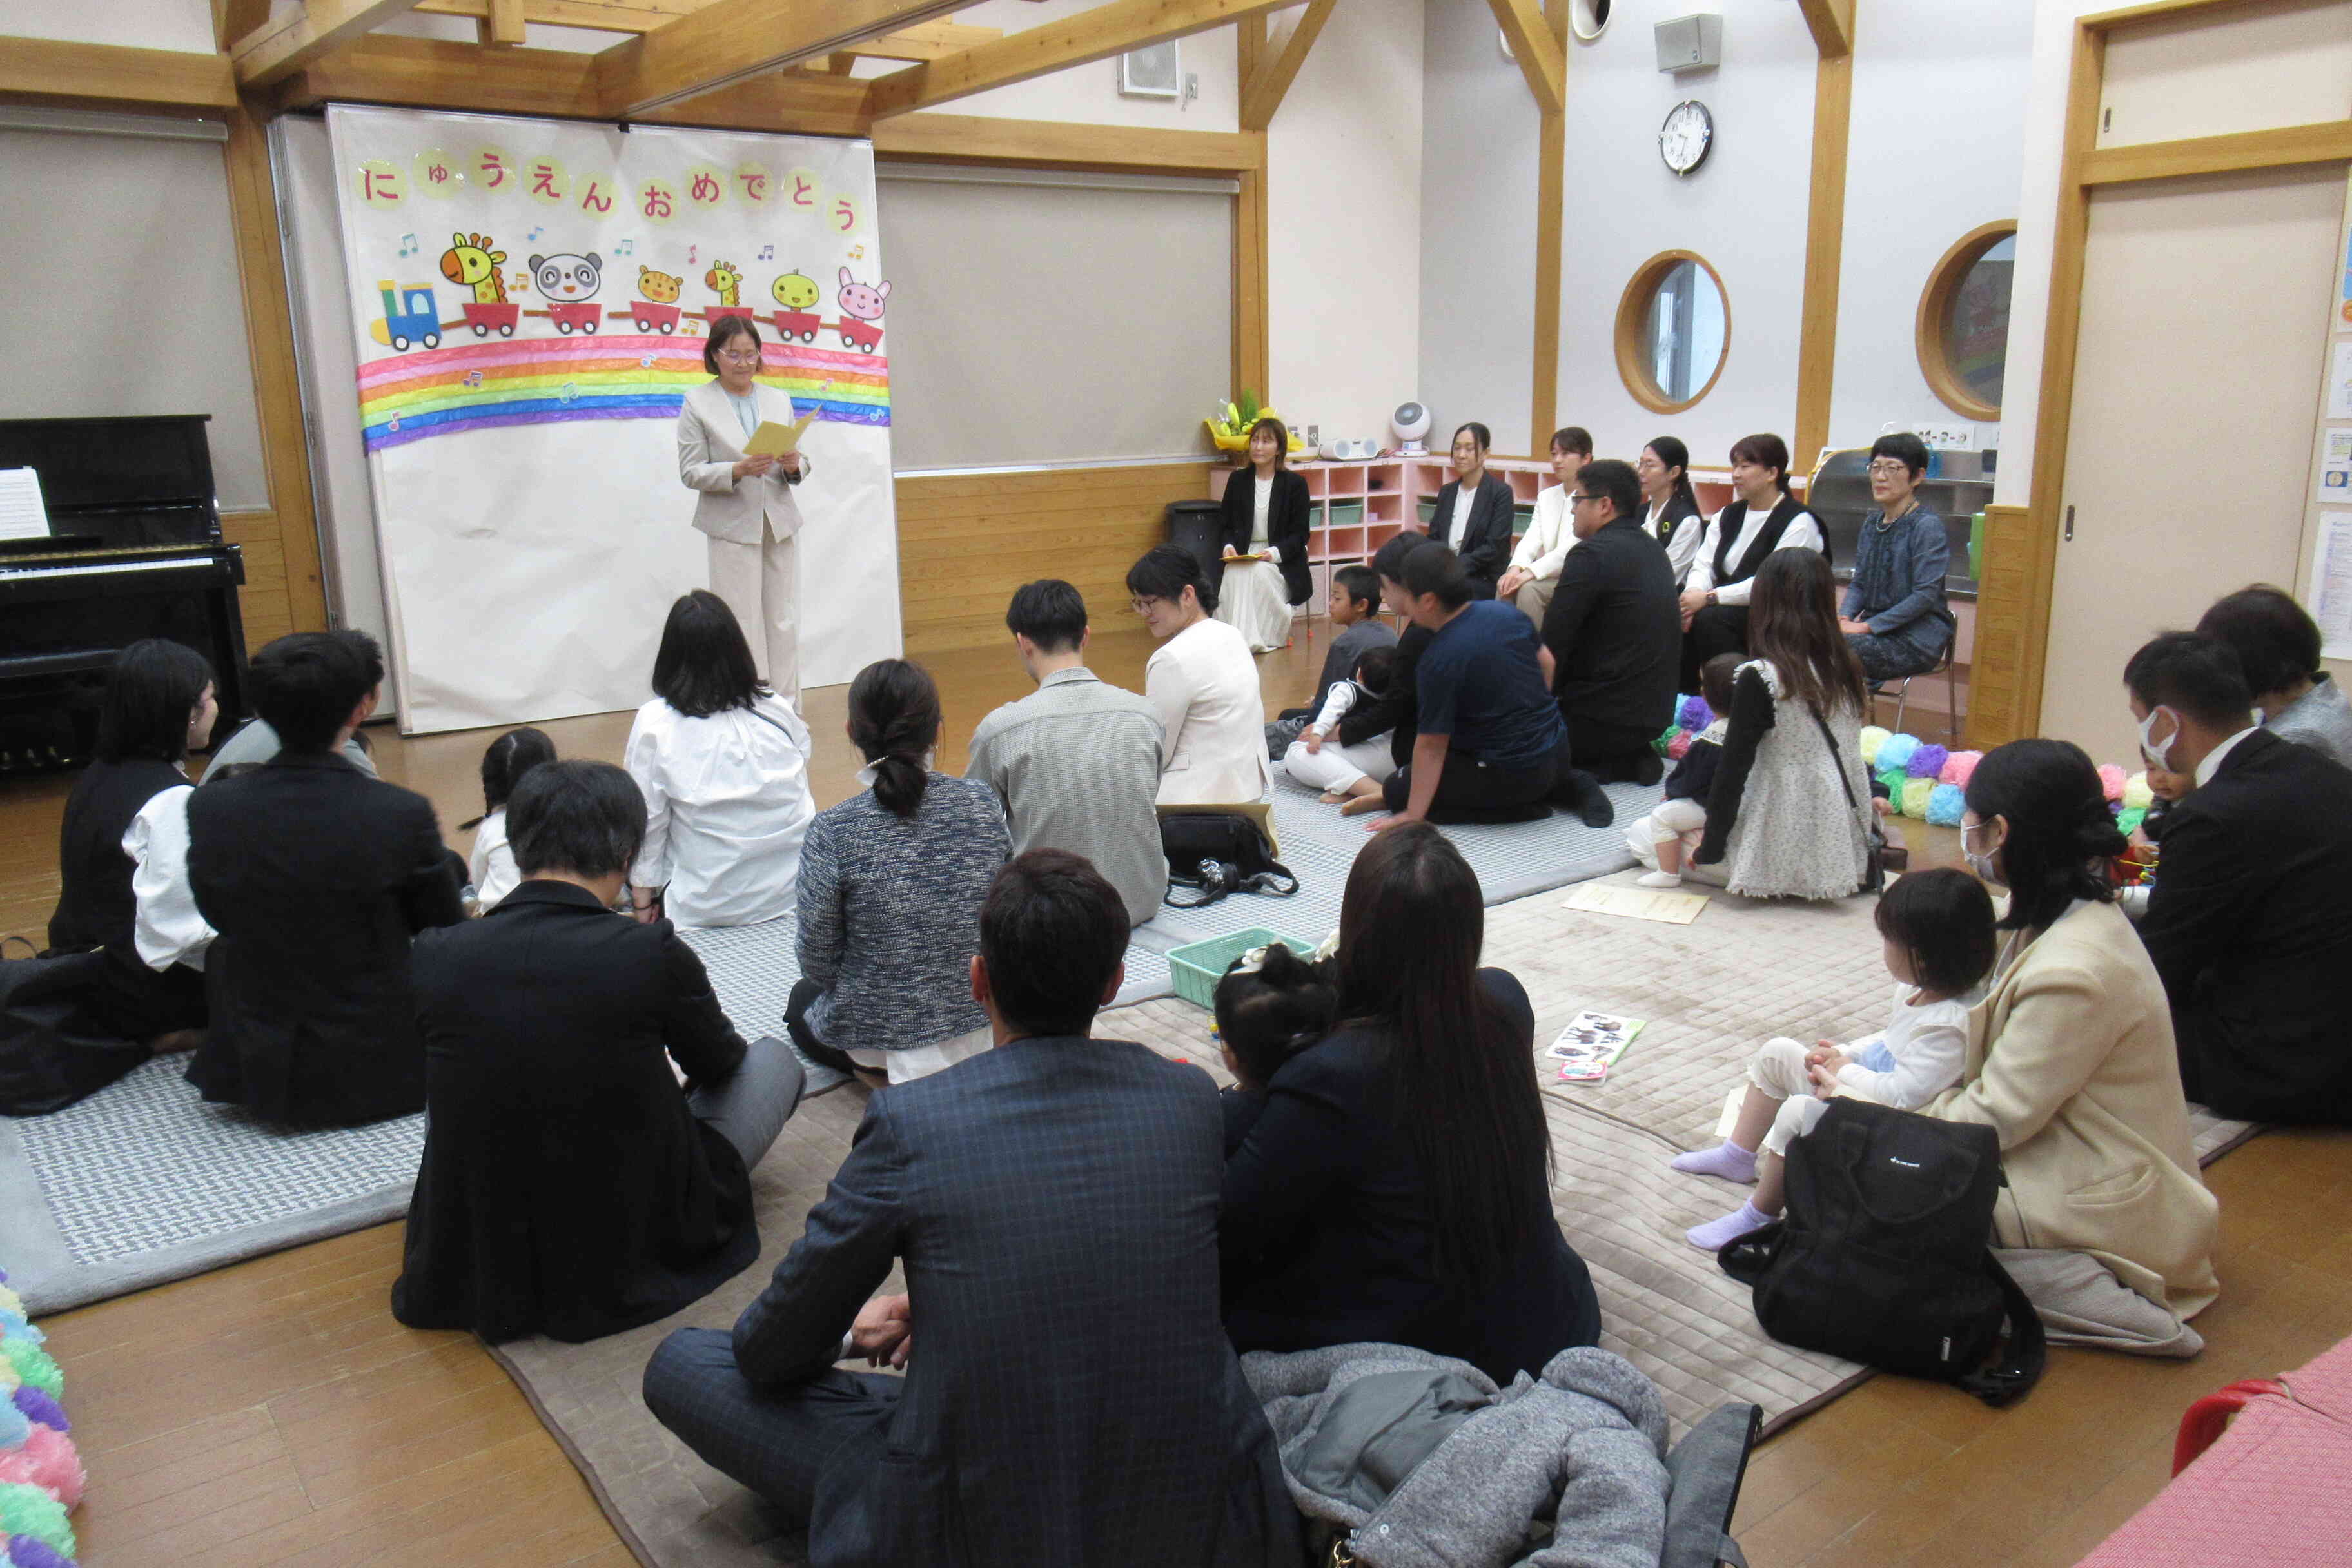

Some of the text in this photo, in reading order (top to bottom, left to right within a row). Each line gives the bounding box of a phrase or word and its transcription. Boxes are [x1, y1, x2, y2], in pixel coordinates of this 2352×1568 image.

[365, 153, 854, 231] にゅうえん おめでとう
